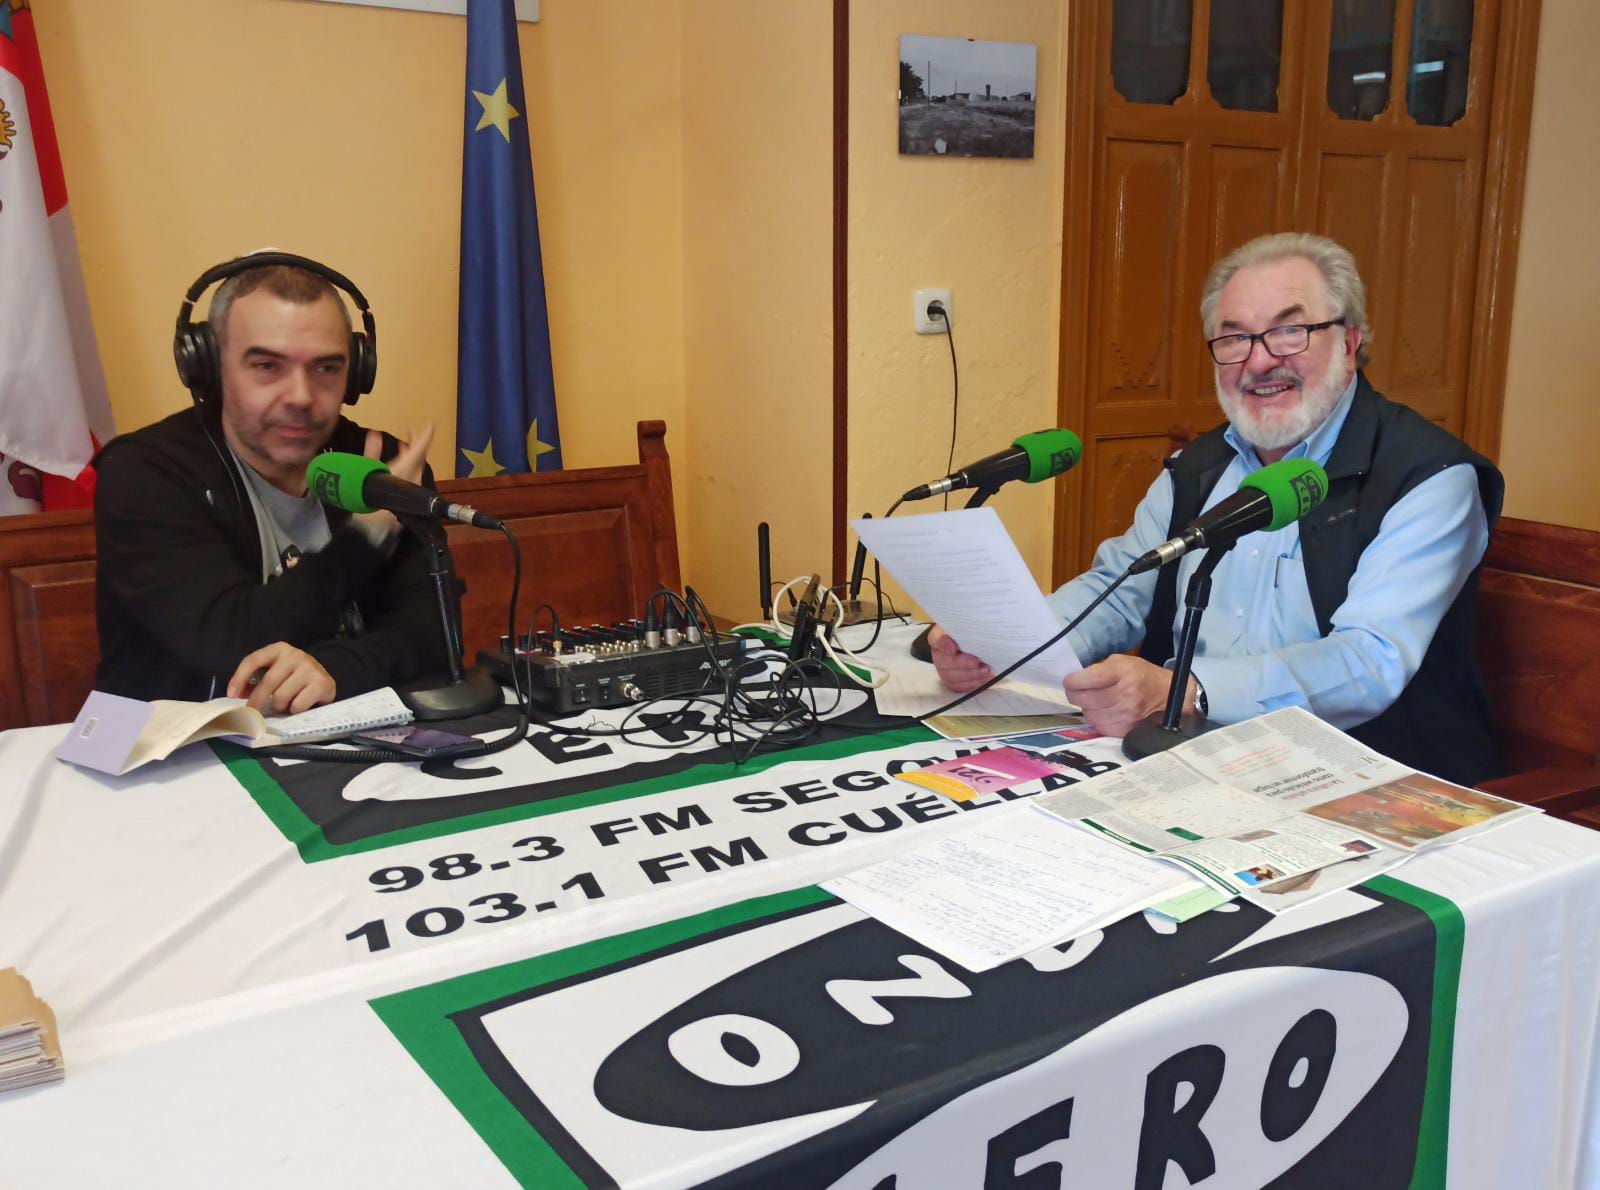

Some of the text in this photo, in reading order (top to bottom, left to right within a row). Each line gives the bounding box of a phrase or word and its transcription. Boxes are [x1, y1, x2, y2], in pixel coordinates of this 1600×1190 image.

[345, 872, 606, 953] 103.1
[638, 836, 768, 885] FM
[368, 834, 565, 893] 98.3
[590, 804, 713, 847] FM
